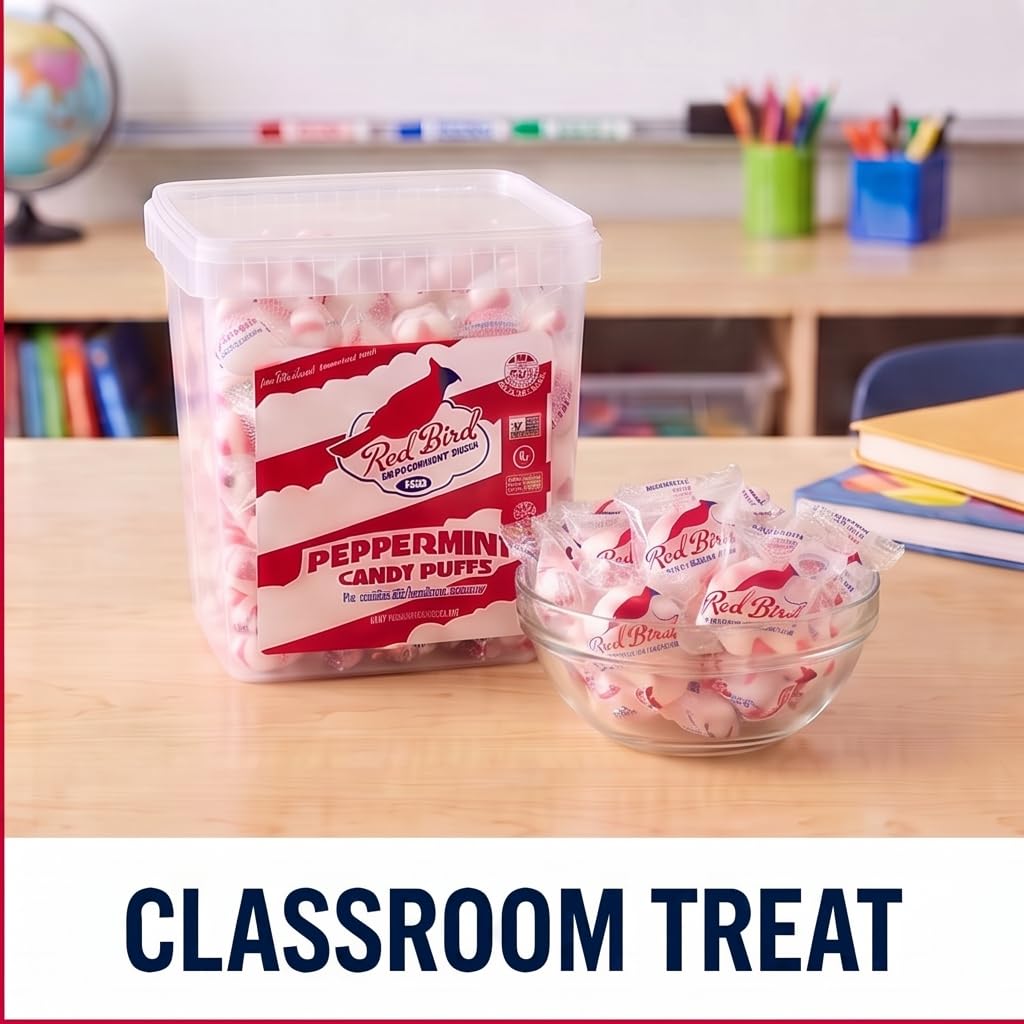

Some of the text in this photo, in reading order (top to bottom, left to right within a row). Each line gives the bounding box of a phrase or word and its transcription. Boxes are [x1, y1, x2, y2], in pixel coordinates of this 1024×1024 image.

[361, 431, 417, 477] Red
[418, 408, 481, 455] Bird
[338, 559, 493, 586] CANDY PUFFS
[702, 589, 756, 616] Red
